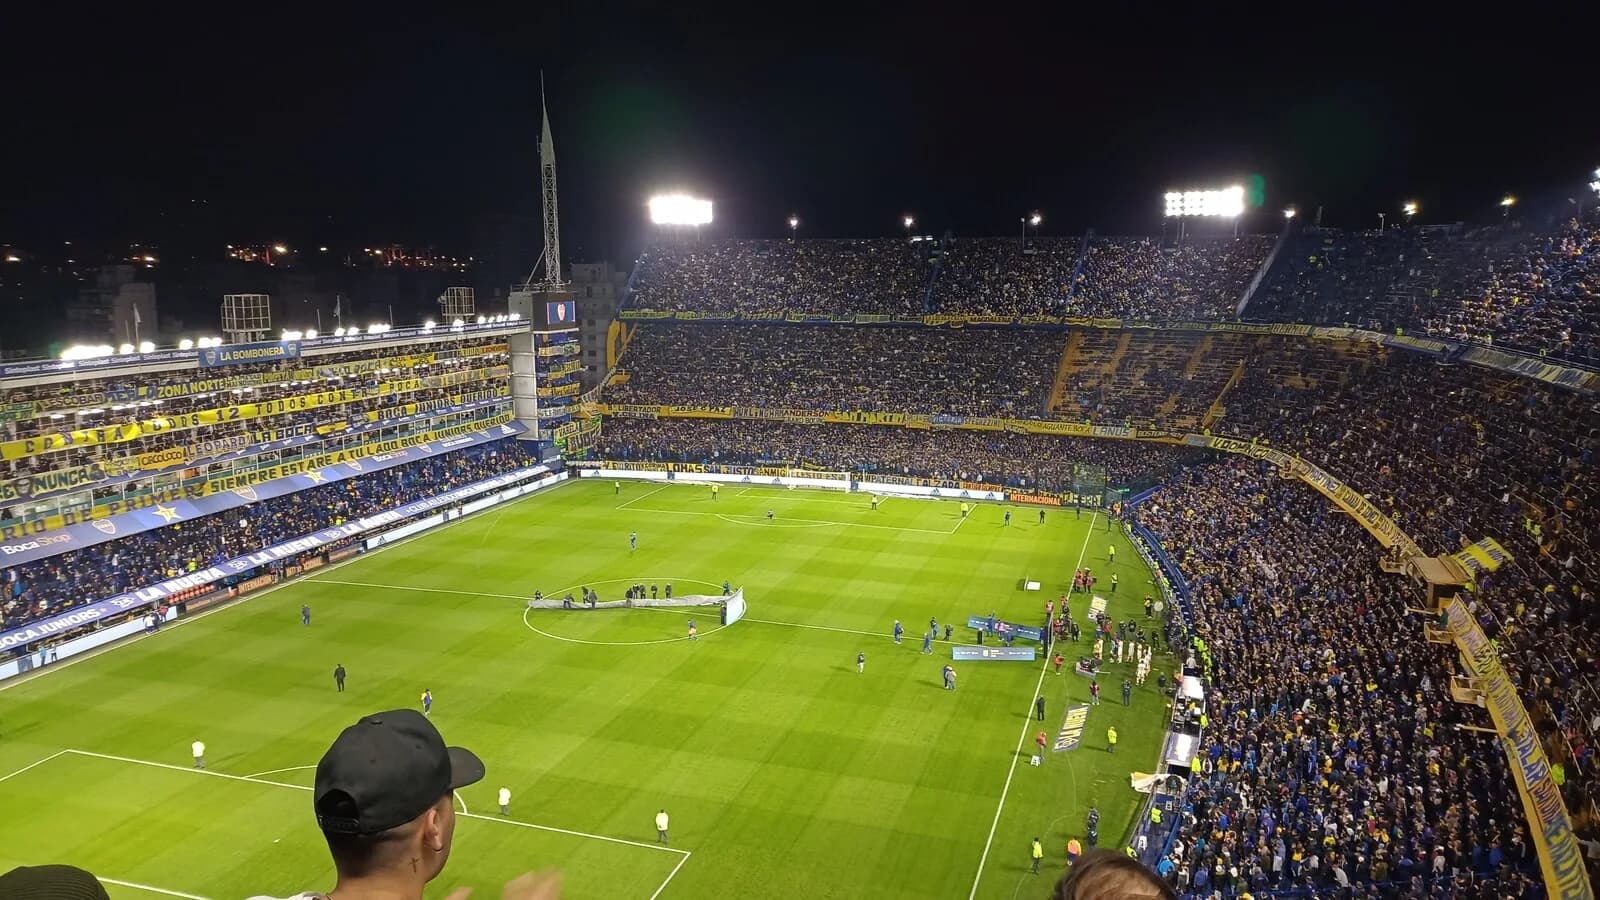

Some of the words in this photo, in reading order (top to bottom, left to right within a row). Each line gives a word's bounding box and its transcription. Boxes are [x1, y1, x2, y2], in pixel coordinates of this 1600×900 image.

[220, 351, 232, 361] LA
[233, 346, 285, 360] BOMBONERA
[158, 384, 188, 398] ZONA
[191, 378, 225, 393] NORTE
[216, 407, 240, 422] 12
[255, 397, 306, 415] TODOS
[1093, 427, 1130, 437] LANUS
[211, 467, 277, 493] SIEMPRE
[281, 455, 335, 476] ESTARE
[402, 433, 431, 448] BOCA
[434, 425, 472, 441] JUNIORS
[474, 414, 511, 431] QUERIDO
[36, 467, 89, 490] NUNCA
[1010, 494, 1062, 506] INTERNACIONAL
[1, 541, 40, 555] Boca
[36, 534, 71, 547] Shop
[249, 549, 271, 565] LA
[271, 535, 322, 559] NUEVA
[136, 586, 162, 601] LA
[163, 568, 226, 592] NUEVA
[39, 608, 100, 634] JUNIORS
